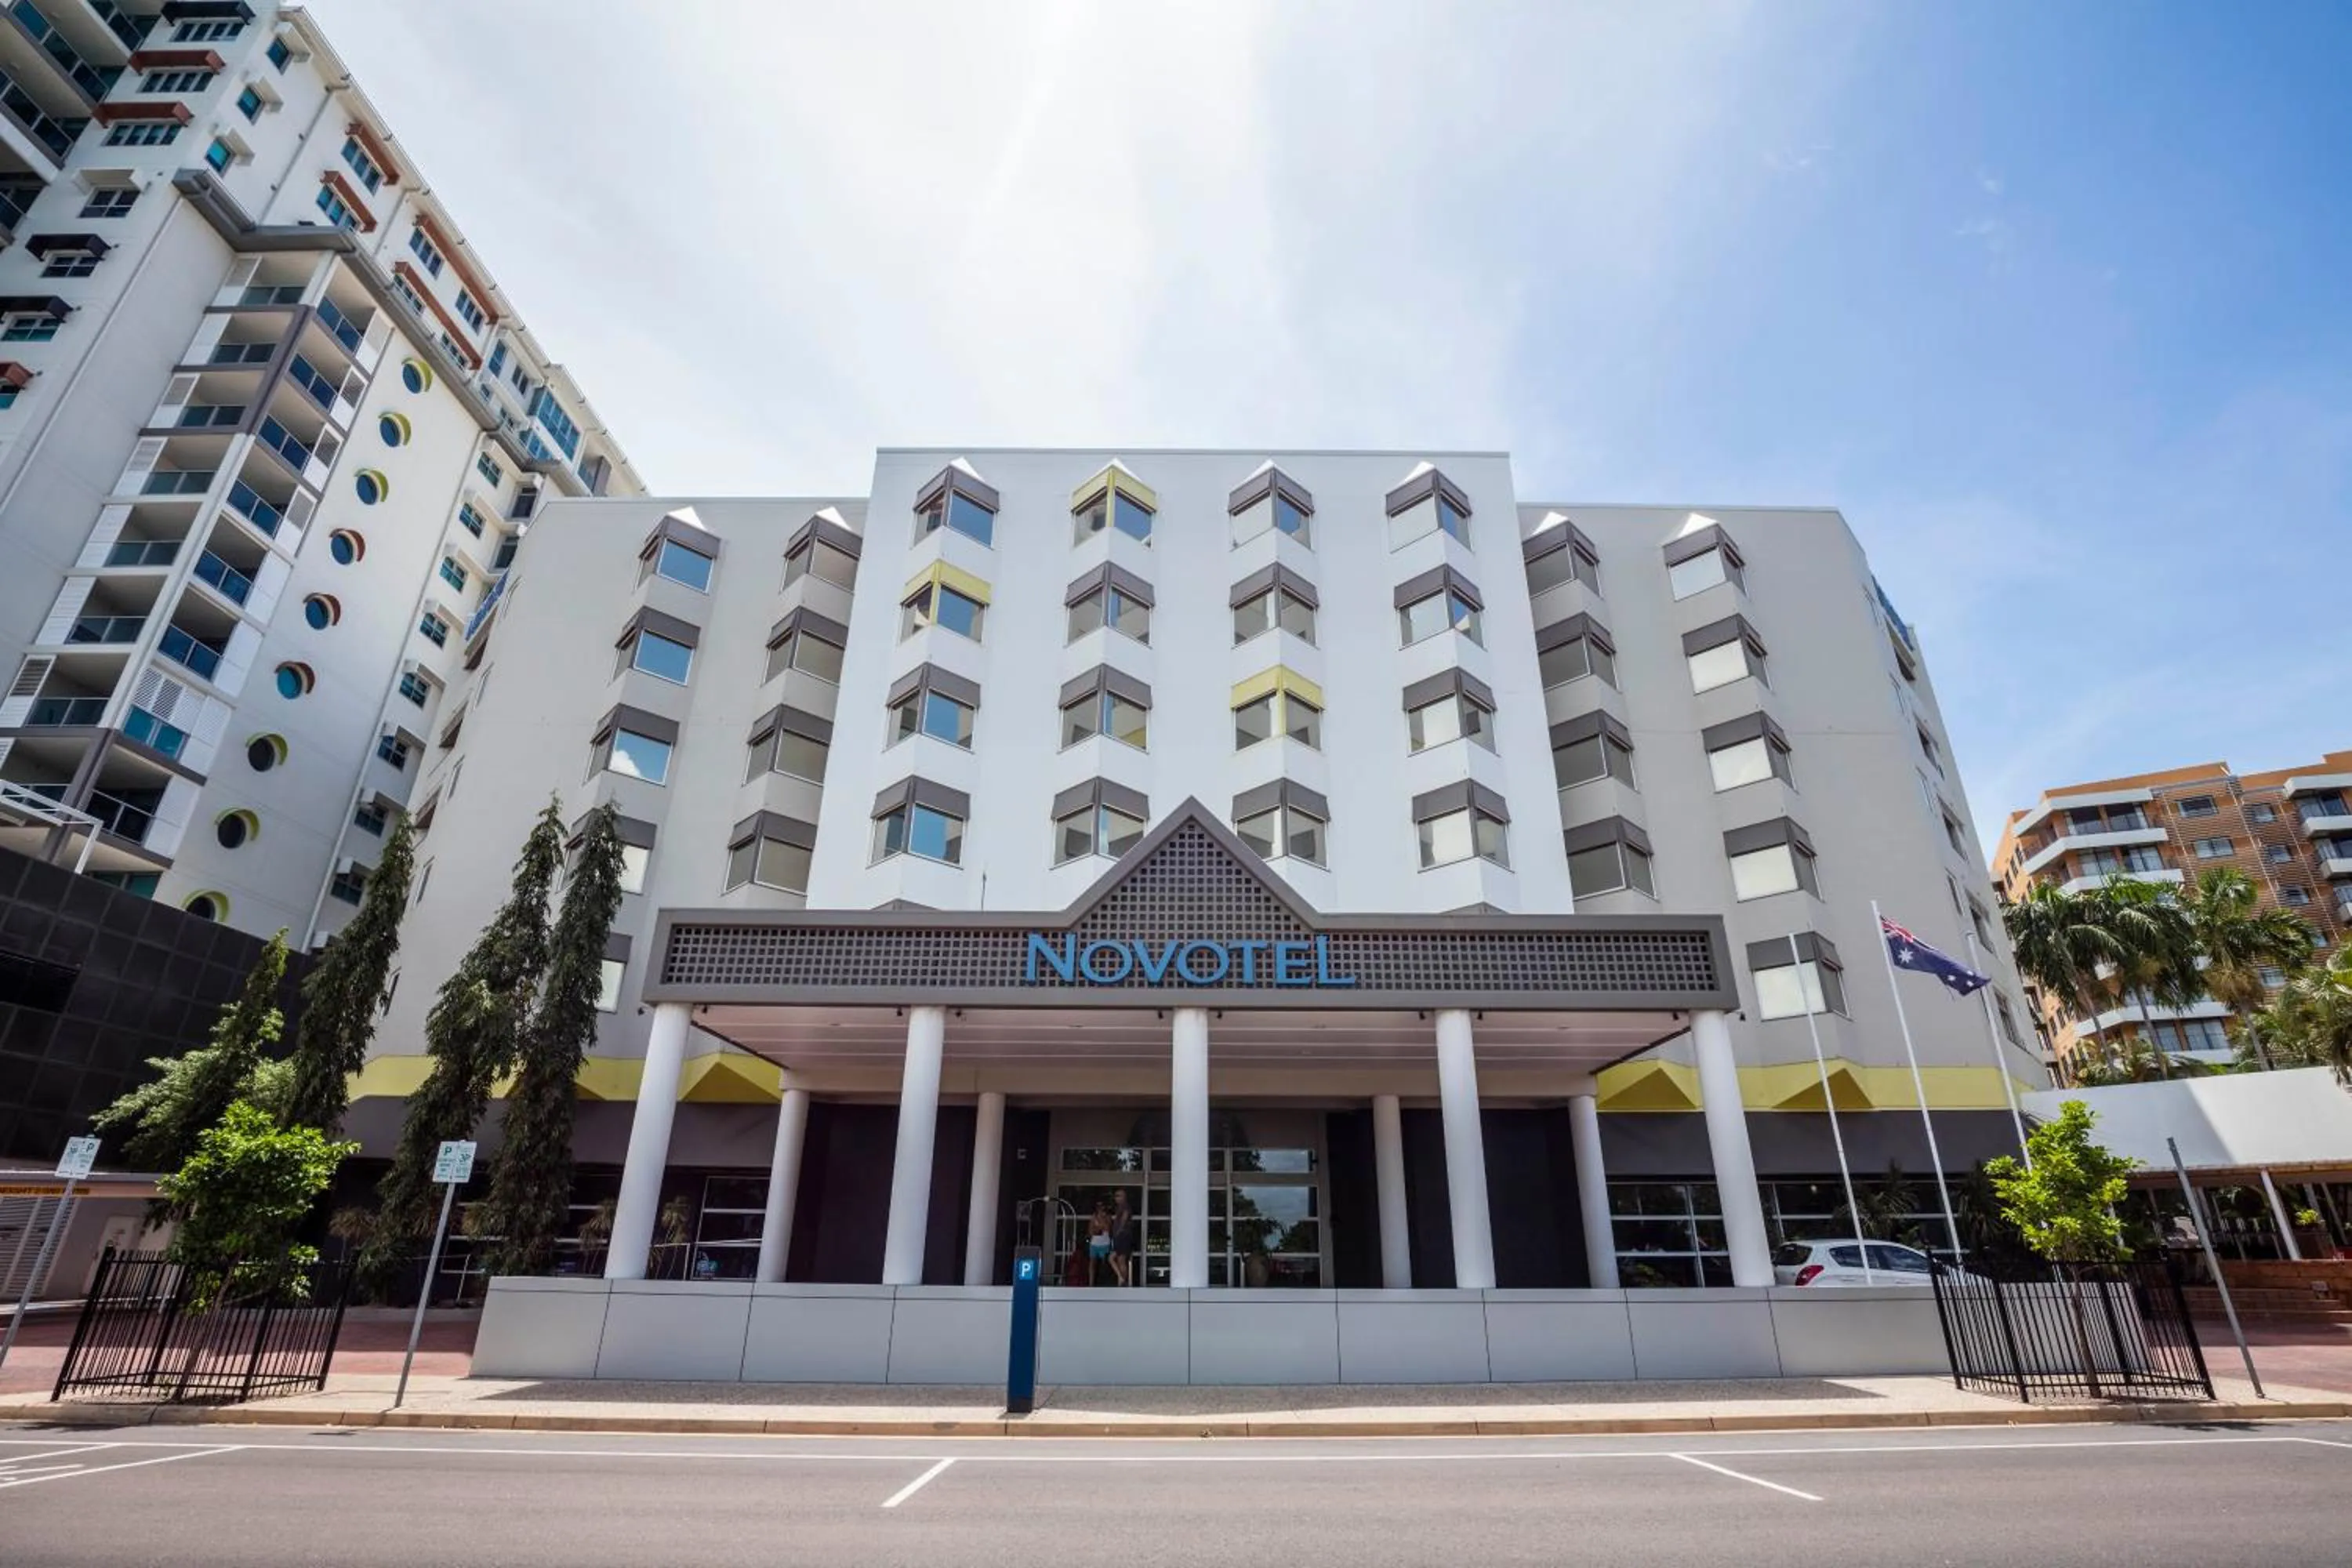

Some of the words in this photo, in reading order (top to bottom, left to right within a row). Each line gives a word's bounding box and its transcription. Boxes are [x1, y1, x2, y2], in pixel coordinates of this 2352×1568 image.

[1025, 933, 1356, 985] NOVOTEL
[443, 1145, 452, 1156] P
[1022, 1261, 1031, 1277] P
